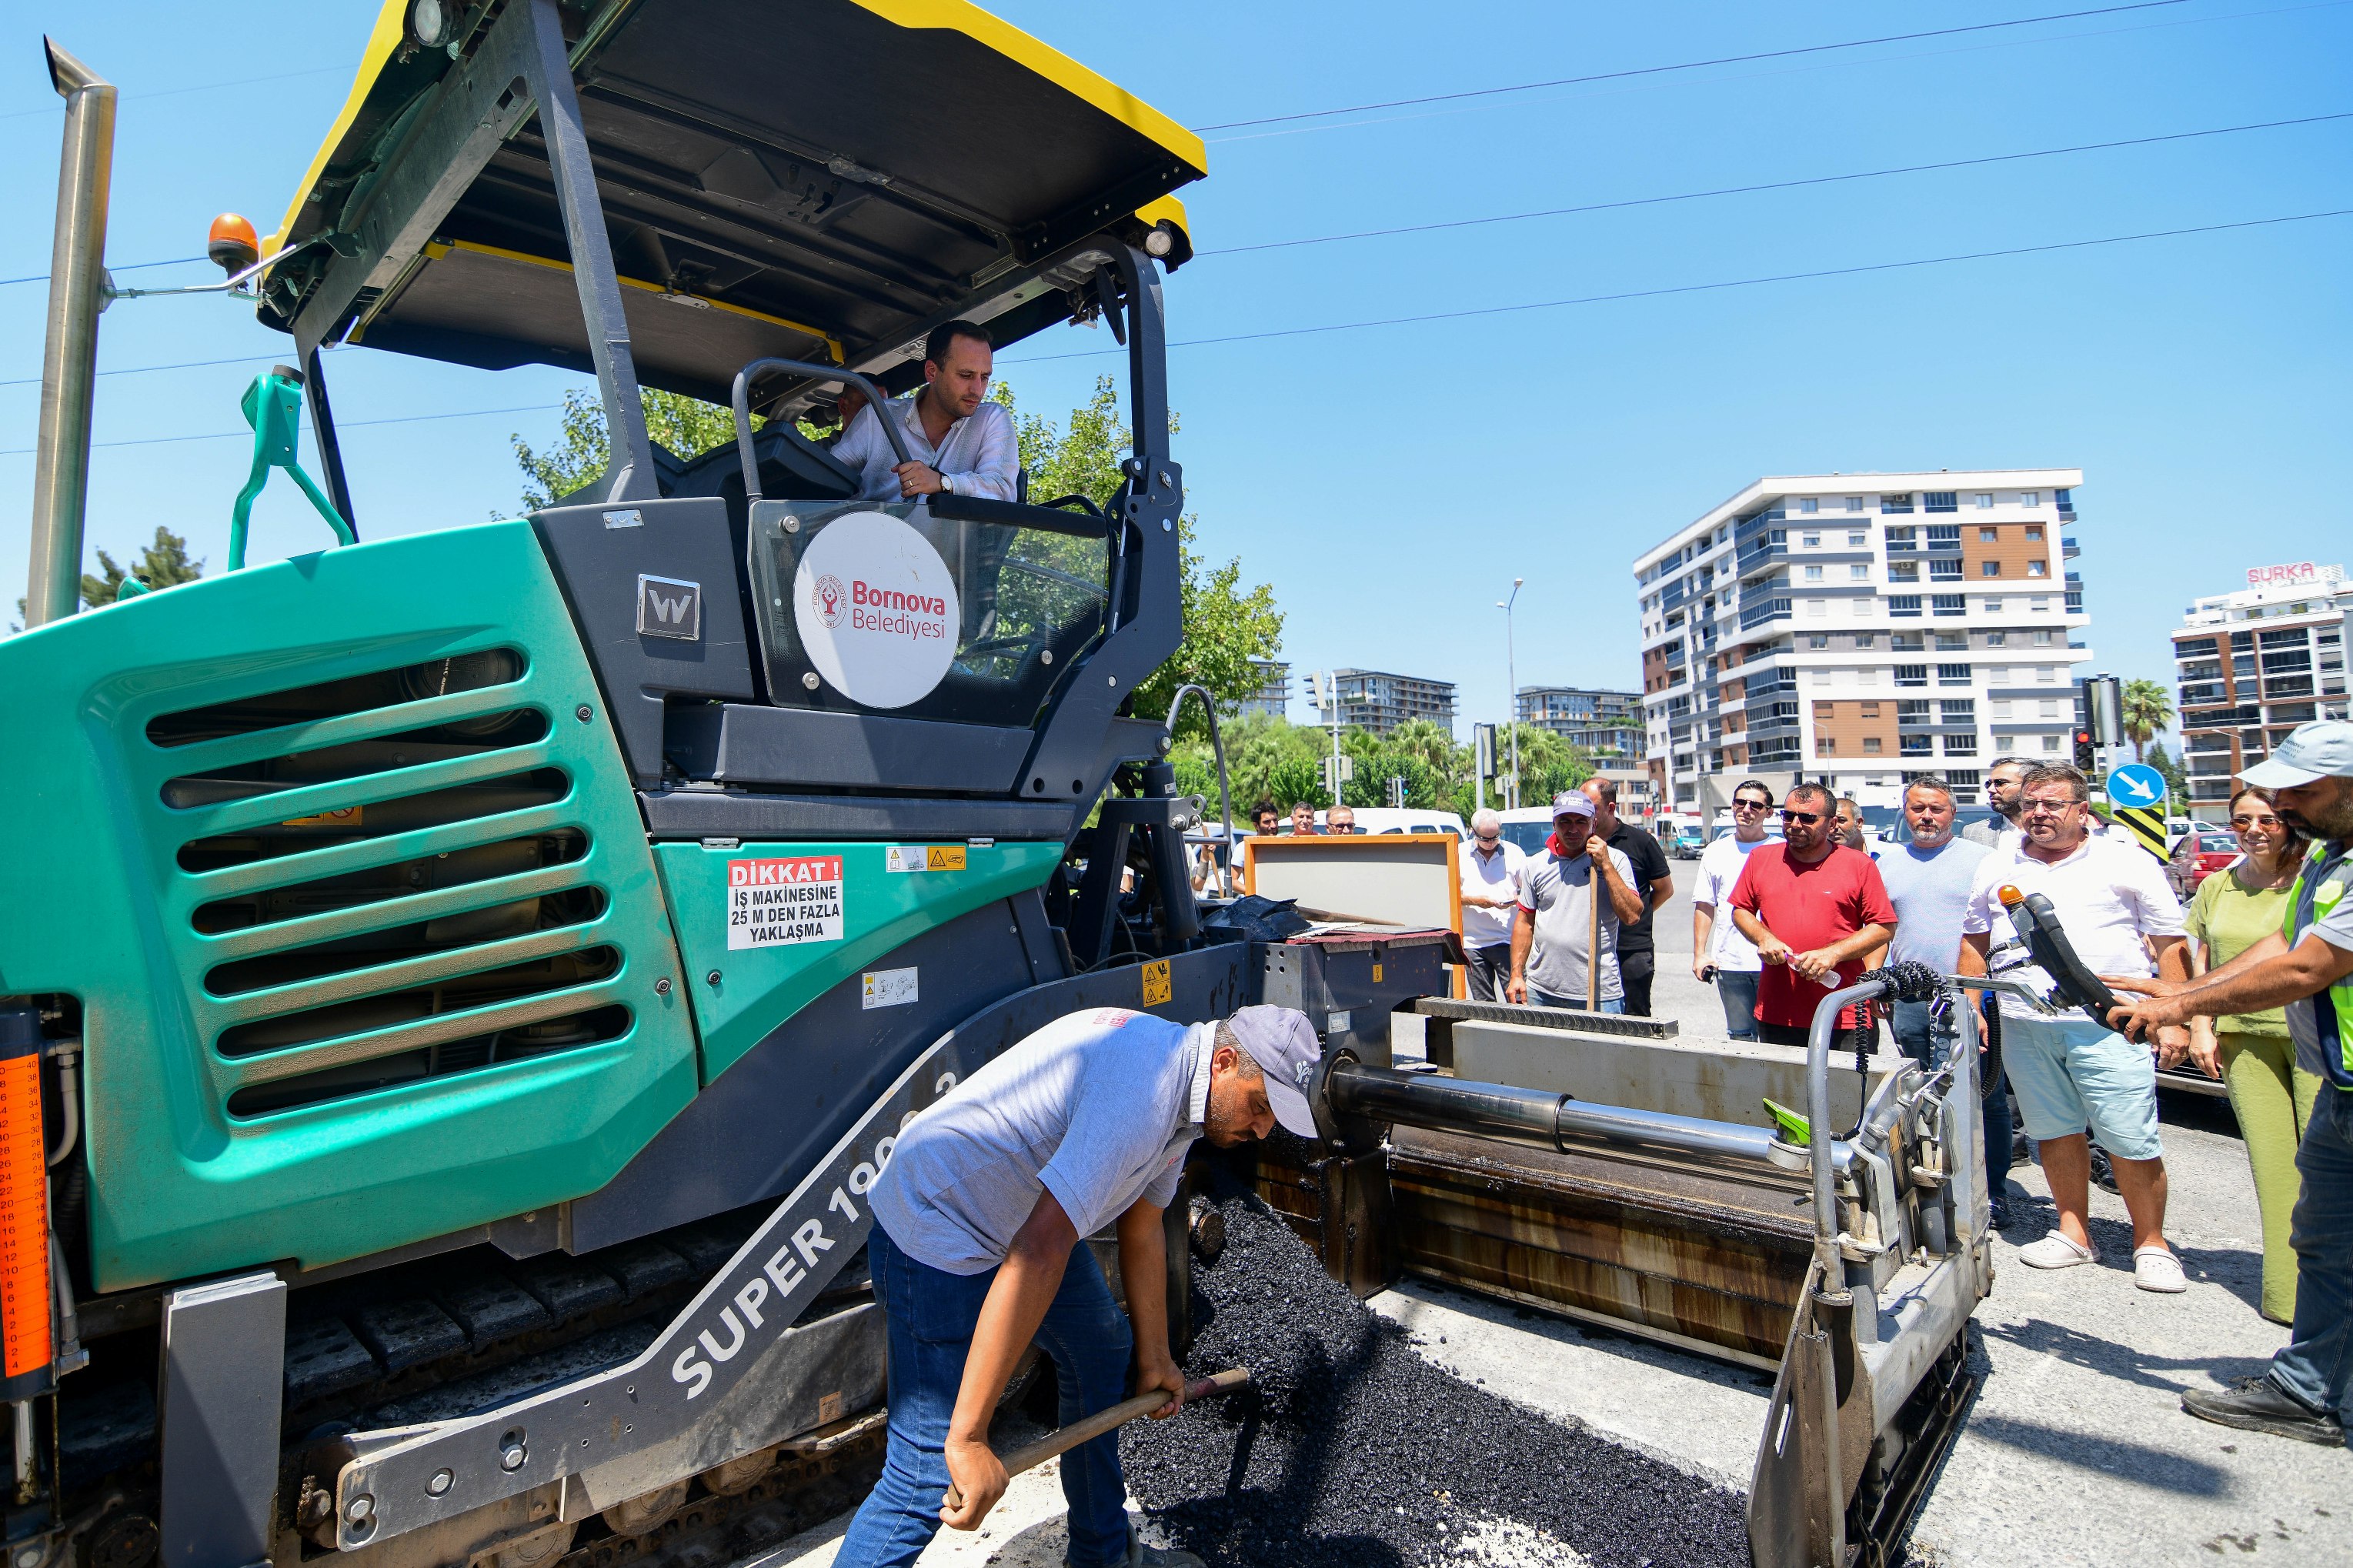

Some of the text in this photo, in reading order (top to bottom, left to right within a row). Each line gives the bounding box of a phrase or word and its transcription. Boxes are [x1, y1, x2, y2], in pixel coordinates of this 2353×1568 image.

[2248, 562, 2314, 582] SURKA
[853, 581, 945, 616] Bornova
[853, 608, 944, 641] Belediyesi
[732, 861, 826, 886] DİKKAT
[735, 884, 837, 909] İŞ MAKİNESİNE
[732, 903, 839, 926] 25 M DEN FAZLA
[749, 922, 824, 942] YAKLAŞMA
[27, 1060, 36, 1069] 40
[27, 1073, 37, 1083] 38
[28, 1086, 38, 1096] 36
[28, 1099, 38, 1108] 34
[29, 1113, 39, 1122] 32
[30, 1126, 40, 1134] 30
[31, 1139, 41, 1147] 28
[32, 1152, 42, 1160] 26
[33, 1165, 42, 1173] 24
[34, 1177, 43, 1187] 22
[35, 1190, 44, 1199] 20
[1, 1200, 14, 1209] 20
[36, 1203, 45, 1212] 18
[2, 1213, 14, 1222] 18
[37, 1216, 45, 1225] 16
[3, 1226, 15, 1236] 16
[38, 1229, 46, 1238] 14
[4, 1240, 15, 1249] 14
[39, 1243, 47, 1252] 12
[5, 1253, 17, 1262] 12
[40, 1256, 48, 1265] 10
[5, 1266, 18, 1276] 10
[8, 1294, 15, 1303] 6
[9, 1307, 15, 1316] 4
[672, 1218, 836, 1400] SUPER
[11, 1334, 17, 1343] 0
[12, 1348, 18, 1356] 2
